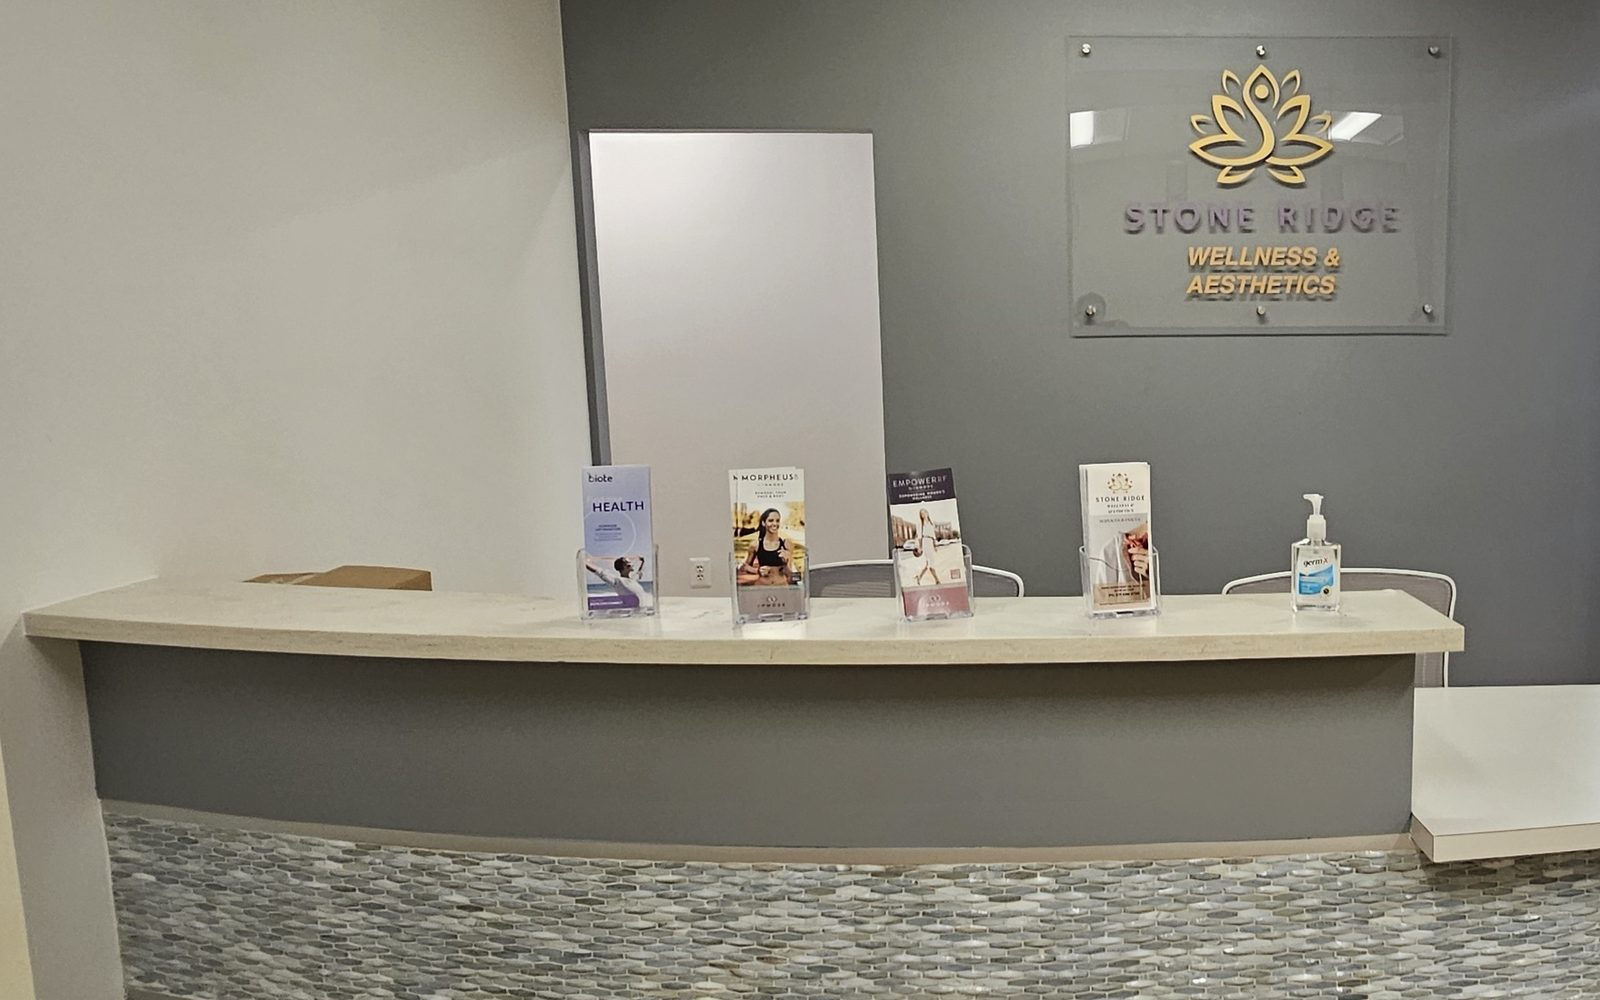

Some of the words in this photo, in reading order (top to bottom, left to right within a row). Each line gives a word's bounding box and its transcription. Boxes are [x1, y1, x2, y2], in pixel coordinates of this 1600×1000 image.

[1124, 206, 1255, 233] STONE
[1277, 206, 1401, 233] RIDGE
[1188, 246, 1318, 267] WELLNESS
[1323, 247, 1341, 267] &
[1186, 274, 1338, 295] AESTHETICS
[587, 472, 613, 483] biote
[592, 501, 645, 512] HEALTH
